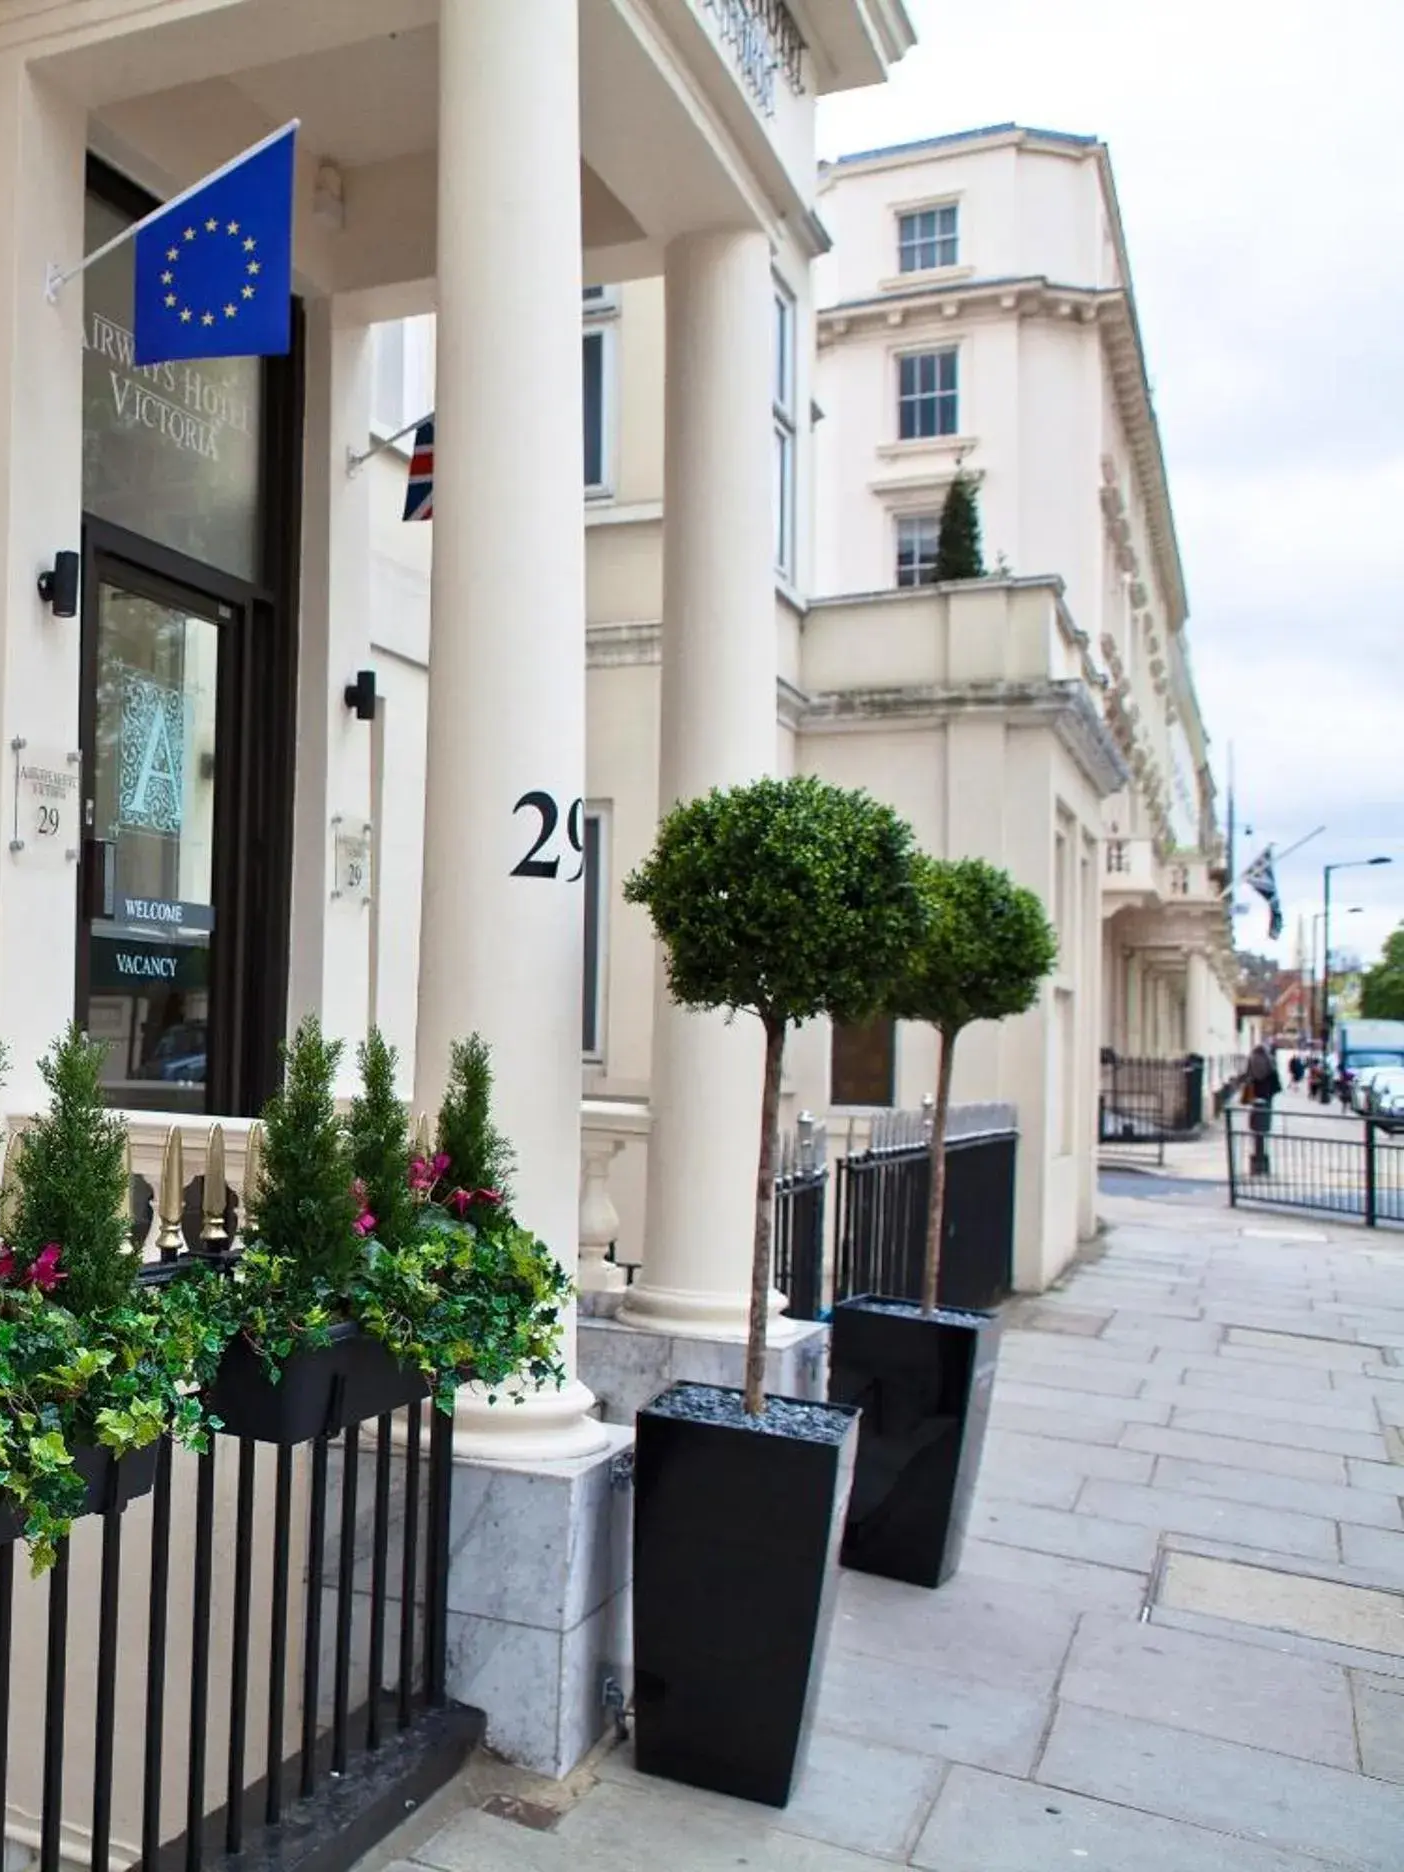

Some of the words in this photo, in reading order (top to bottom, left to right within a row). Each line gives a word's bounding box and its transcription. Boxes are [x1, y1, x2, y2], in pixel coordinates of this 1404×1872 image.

[109, 369, 220, 462] VICTORIA
[124, 699, 183, 819] A
[37, 805, 61, 837] 29
[124, 898, 183, 923] WELCOME
[115, 953, 179, 977] VACANCY
